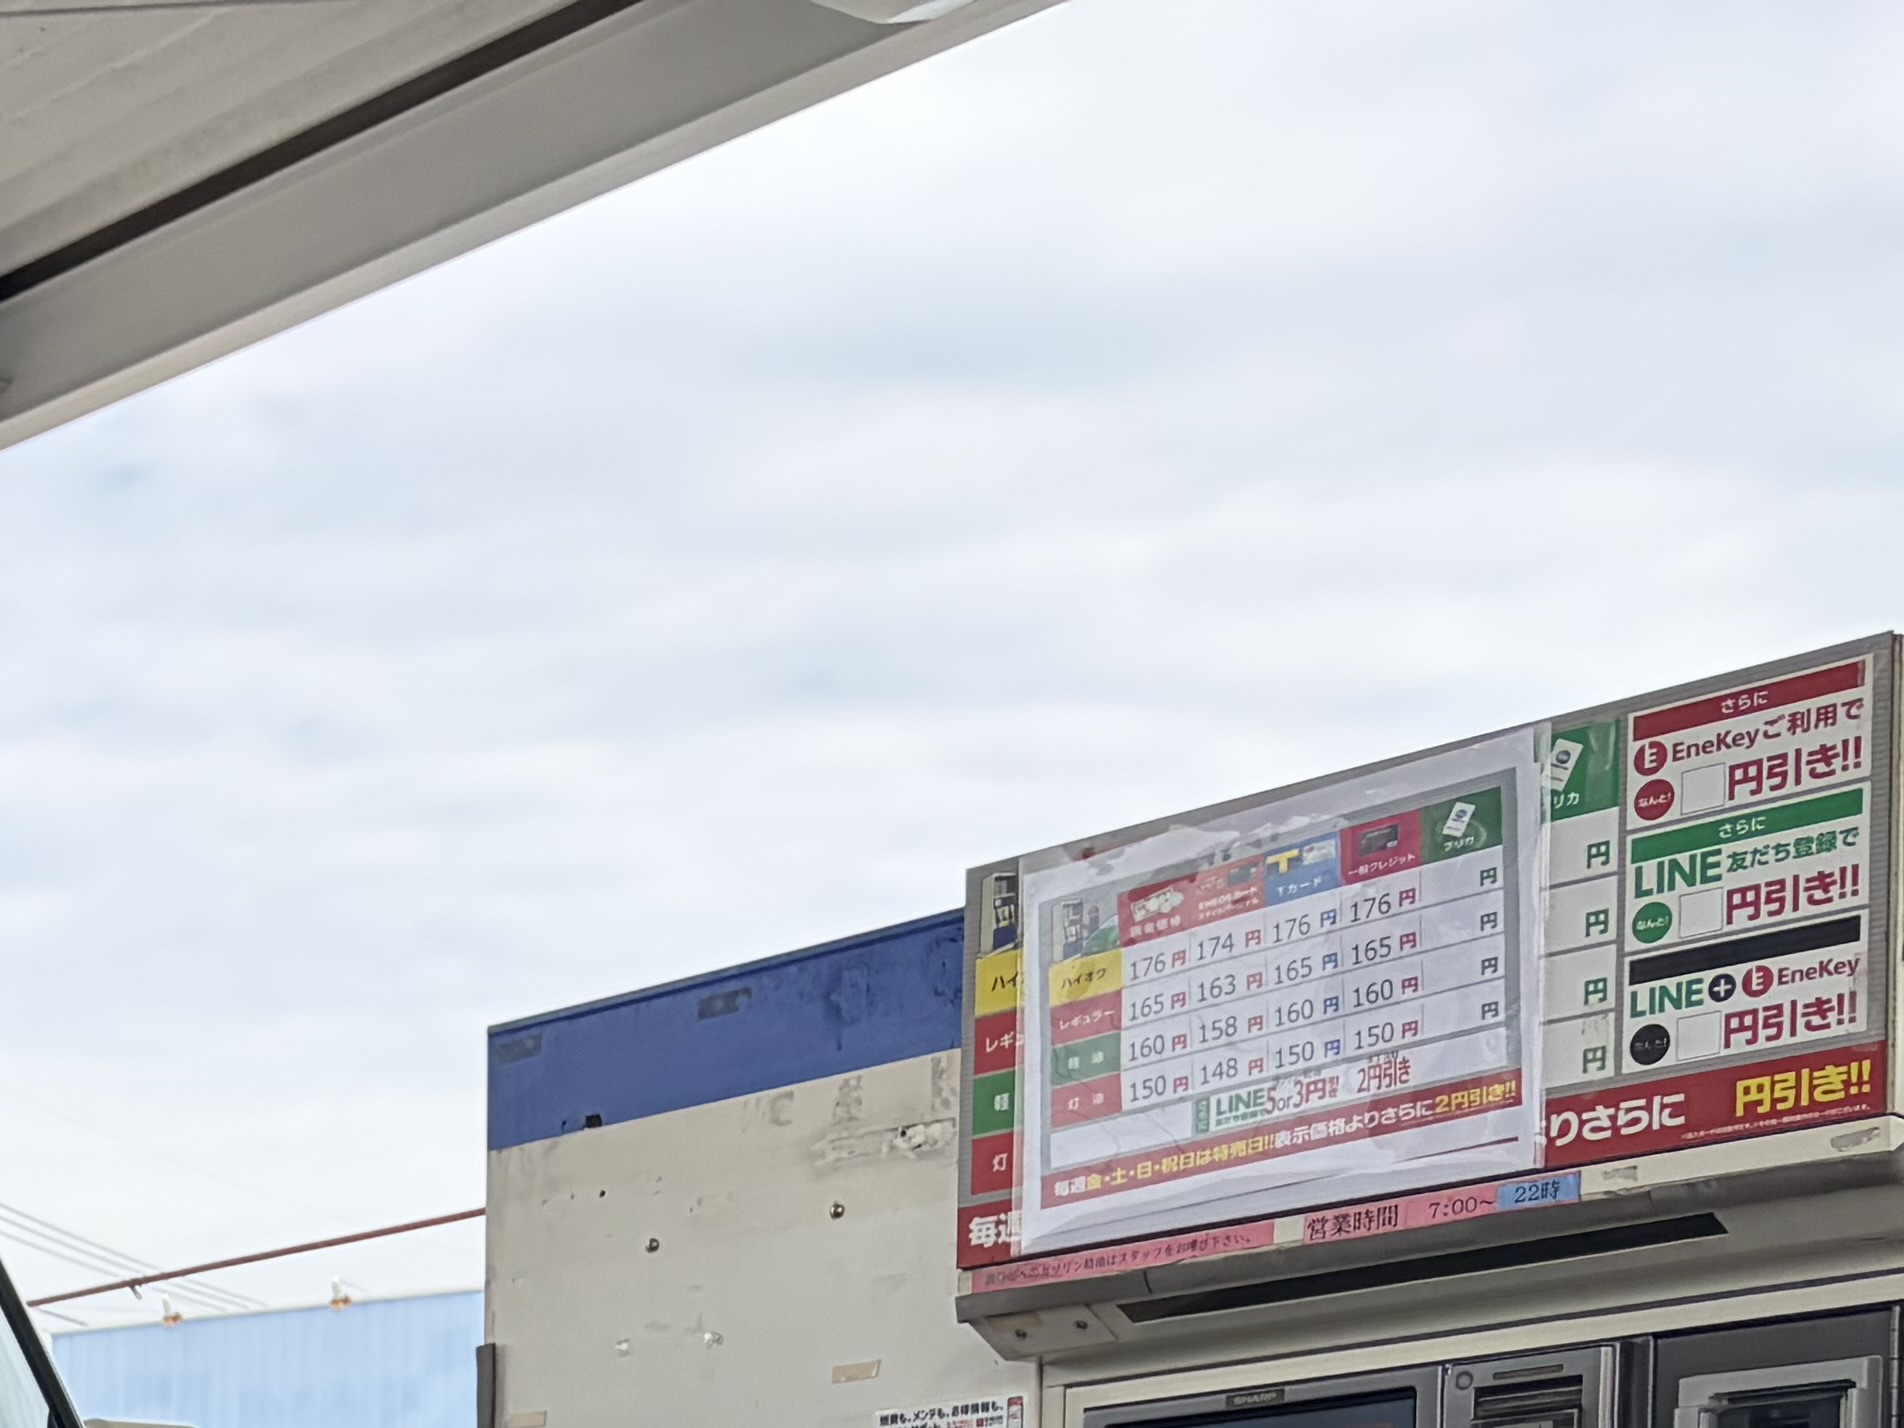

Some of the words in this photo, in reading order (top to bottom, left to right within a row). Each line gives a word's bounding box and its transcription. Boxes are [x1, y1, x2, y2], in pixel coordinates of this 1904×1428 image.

[1671, 698, 1865, 763] EneKeyご利用で
[1720, 691, 1769, 714] さらに
[1728, 736, 1863, 801] 円引き!!
[1586, 840, 1611, 869] 円
[1718, 816, 1767, 838] さらに
[1634, 848, 1724, 899] LINE
[1725, 827, 1861, 873] 友だち登録で
[1129, 952, 1167, 982] 176
[1171, 950, 1187, 969] 円
[1197, 932, 1235, 961] 174
[1245, 929, 1262, 949] 円
[1272, 913, 1312, 944] 176
[1320, 908, 1338, 928] 円
[1349, 893, 1392, 924] 176
[1398, 887, 1417, 908] 円
[1479, 866, 1498, 887] 円
[1585, 908, 1610, 937] 円
[1725, 863, 1860, 925] 円引き!!
[1128, 993, 1166, 1022] 165
[1170, 991, 1187, 1010] 円
[1197, 974, 1237, 1003] 163
[1246, 971, 1264, 991] 円
[1274, 956, 1313, 985] 165
[1322, 951, 1340, 972] 円
[1351, 936, 1393, 966] 165
[1399, 931, 1418, 951] 円
[1480, 911, 1499, 932] 円
[1583, 977, 1608, 1006] 円
[1629, 977, 1705, 1018] LINE
[1777, 957, 1861, 987] EneKey
[1128, 1034, 1166, 1063] 160
[1171, 1034, 1188, 1053] 円
[1199, 1016, 1238, 1043] 158
[1247, 1014, 1265, 1034] 円
[1275, 999, 1315, 1028] 160
[1323, 995, 1340, 1015] 円
[1352, 979, 1394, 1009] 160
[1401, 975, 1419, 995] 円
[1480, 956, 1499, 976] 円
[1723, 990, 1857, 1049] 円引き!!
[1129, 1075, 1167, 1103] 150
[1172, 1075, 1189, 1094] 円
[1199, 1058, 1239, 1086] 148
[1248, 1057, 1265, 1077] 円
[1274, 1041, 1315, 1070] 150
[1324, 1039, 1342, 1059] 円
[1354, 1022, 1395, 1050] 150
[1401, 1020, 1419, 1040] 円
[1481, 1002, 1500, 1021] 円
[1582, 1046, 1607, 1074] 円
[1215, 1087, 1267, 1117] LINE
[1735, 1059, 1872, 1117] 円引き!!
[992, 1153, 1008, 1172] 灯
[1307, 1204, 1400, 1241] 営業時間
[1514, 1179, 1561, 1204] 22時
